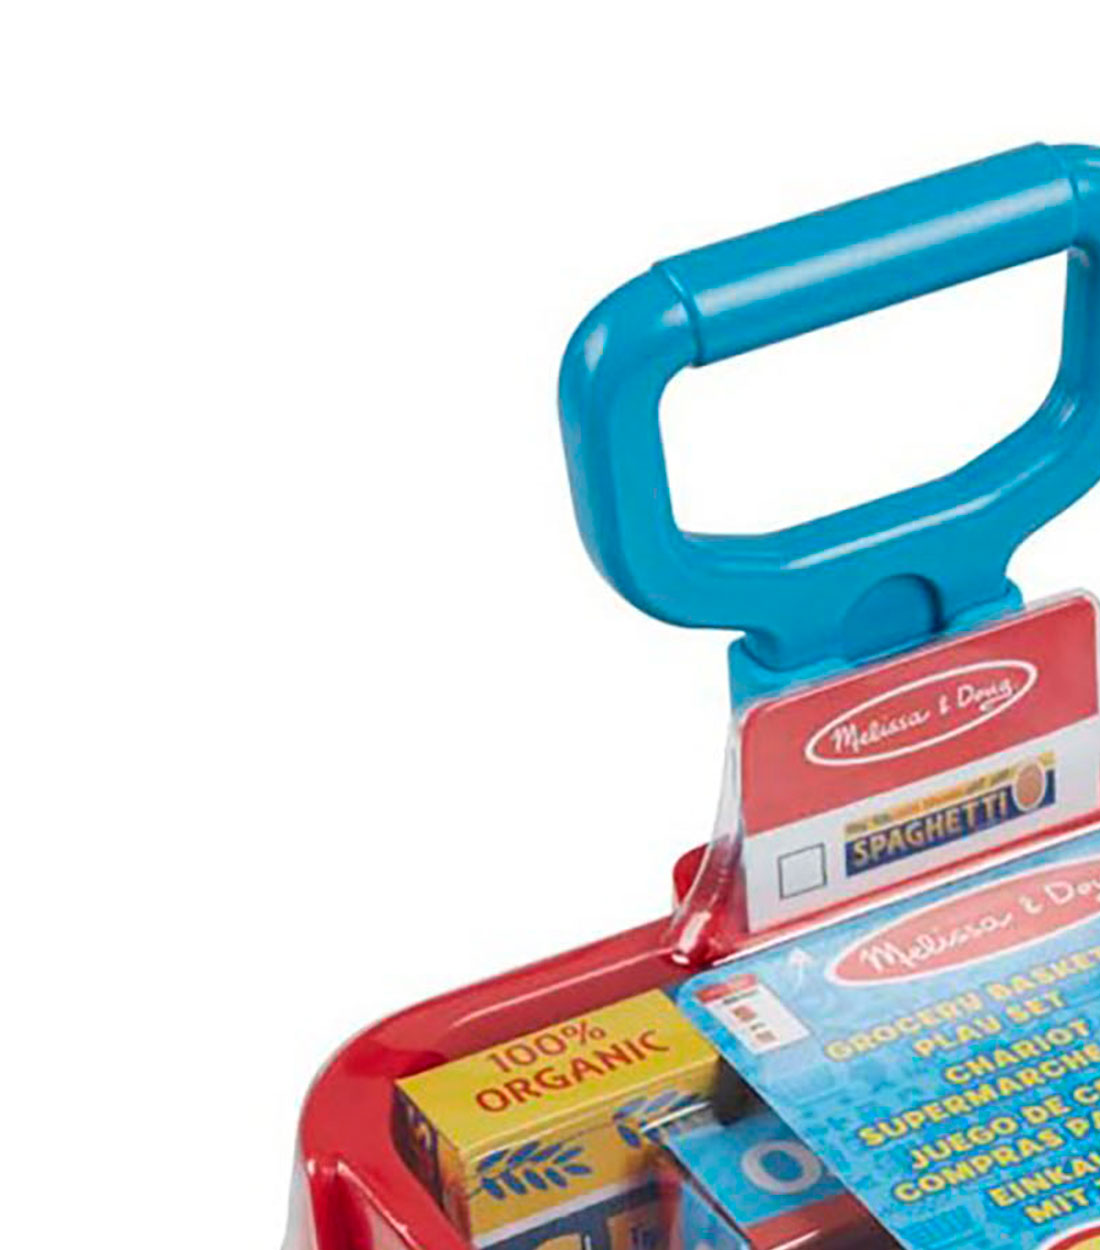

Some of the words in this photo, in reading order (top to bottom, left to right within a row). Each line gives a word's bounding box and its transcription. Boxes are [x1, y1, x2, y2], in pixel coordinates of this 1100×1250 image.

[831, 709, 931, 755] Melissa
[957, 677, 1020, 711] Doug
[852, 791, 1008, 867] SPAGHETTI
[858, 908, 1014, 975] Melissa
[487, 1020, 608, 1074] 100%
[824, 991, 984, 1062] GROCERY
[912, 1015, 1001, 1058] PLAY
[1005, 993, 1067, 1025] SET
[944, 1019, 1090, 1085] CHARIOT
[474, 1029, 670, 1114] ORGANIC
[893, 1129, 1065, 1204] COMPRAS
[911, 1116, 1019, 1171] JUEGO
[1021, 1096, 1071, 1126] DE
[1023, 1188, 1090, 1225] MIT
